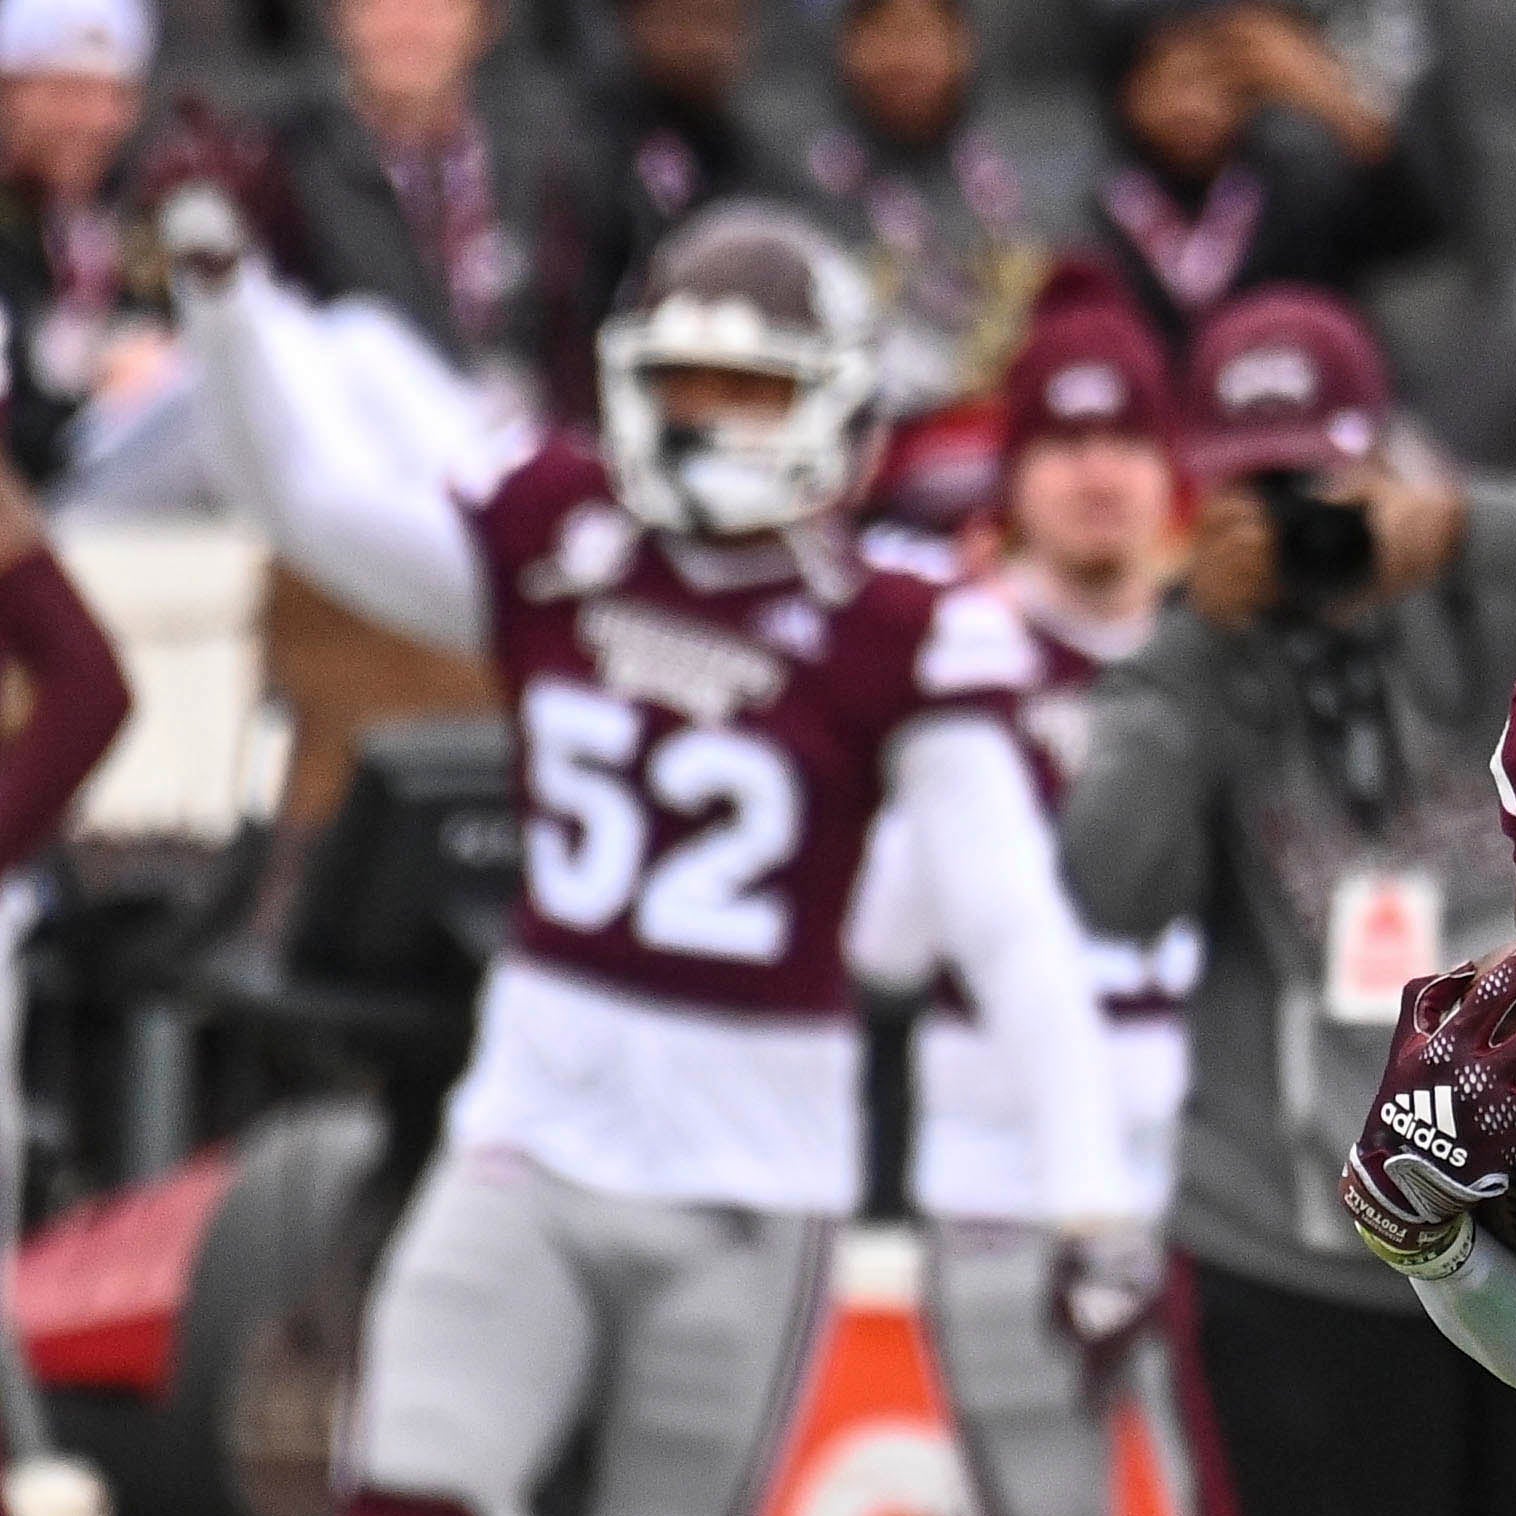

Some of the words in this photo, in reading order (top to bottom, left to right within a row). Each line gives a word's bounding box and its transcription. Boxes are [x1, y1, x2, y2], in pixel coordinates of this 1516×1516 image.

[528, 680, 803, 966] 52
[1380, 1101, 1469, 1168] adidas
[1347, 1184, 1408, 1239] FOOTBALL
